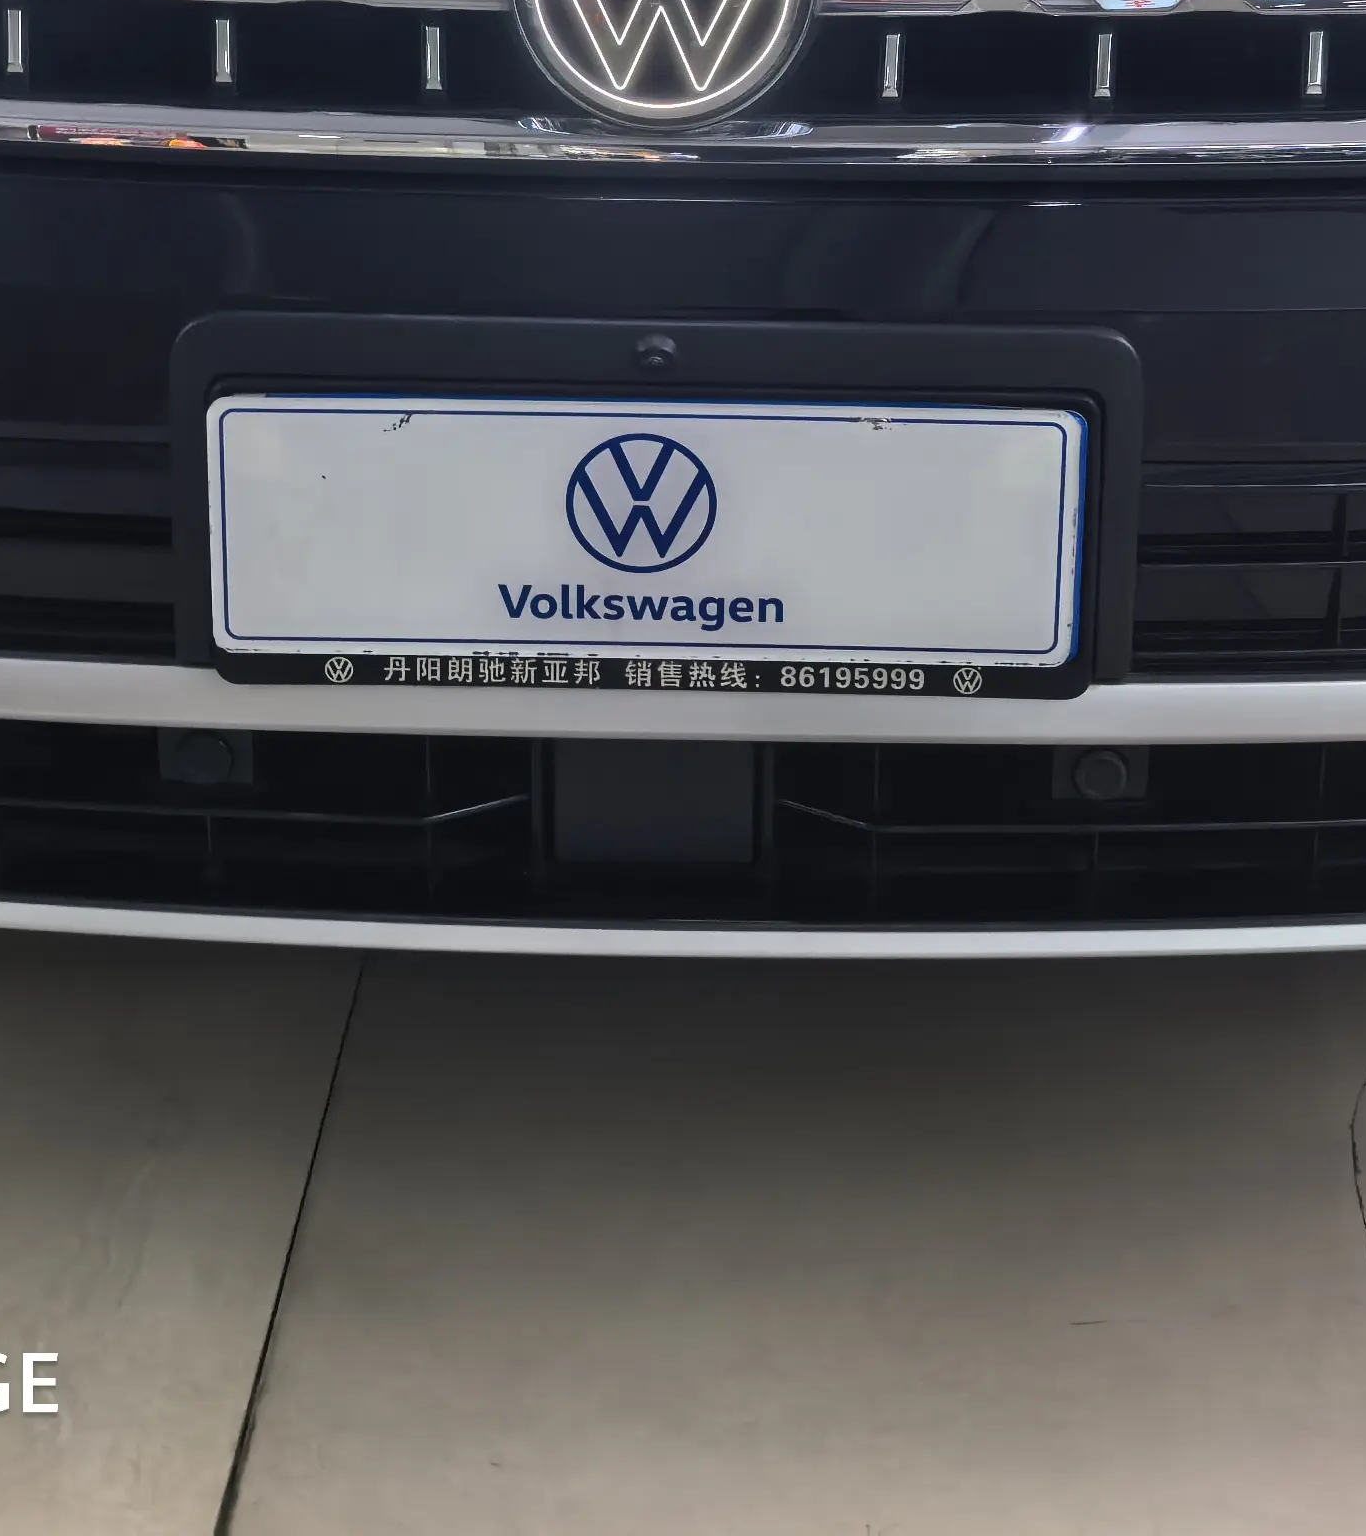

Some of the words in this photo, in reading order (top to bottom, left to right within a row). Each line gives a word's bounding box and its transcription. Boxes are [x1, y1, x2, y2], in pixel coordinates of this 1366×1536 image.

[497, 582, 786, 630] Volkswagen
[382, 656, 602, 687] 丹阳朗驰新亚邦
